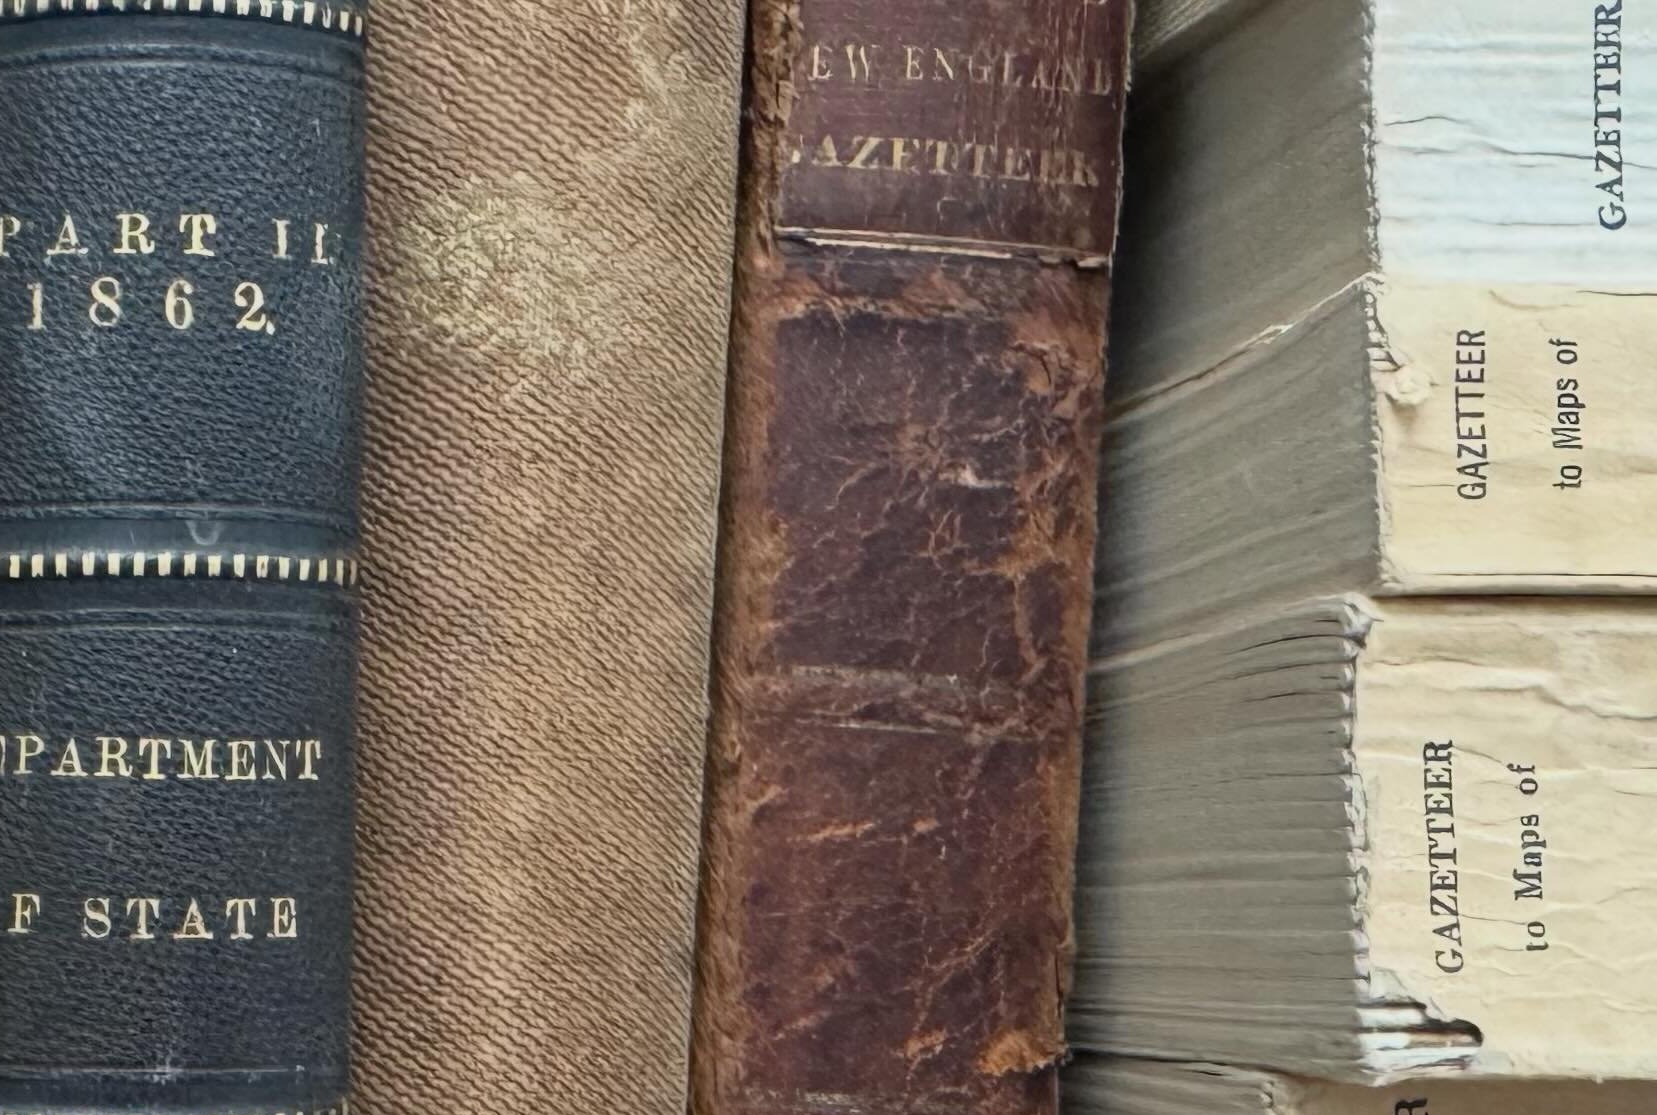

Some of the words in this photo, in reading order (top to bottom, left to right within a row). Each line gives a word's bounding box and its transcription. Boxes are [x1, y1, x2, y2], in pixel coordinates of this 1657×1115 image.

[806, 44, 882, 81] EW
[902, 45, 1112, 96] ENGLAND
[1594, 0, 1628, 231] GAZETTEER
[789, 134, 1101, 188] AZETTEER
[1547, 337, 1579, 365] of
[1453, 329, 1490, 501] GAZETTEER
[1550, 377, 1586, 451] Maps
[1551, 464, 1583, 491] to
[1505, 762, 1540, 796] of
[1422, 739, 1465, 974] GAZETTEER
[1512, 813, 1548, 902] Maps
[80, 893, 300, 941] STATE
[1525, 920, 1550, 952] to
